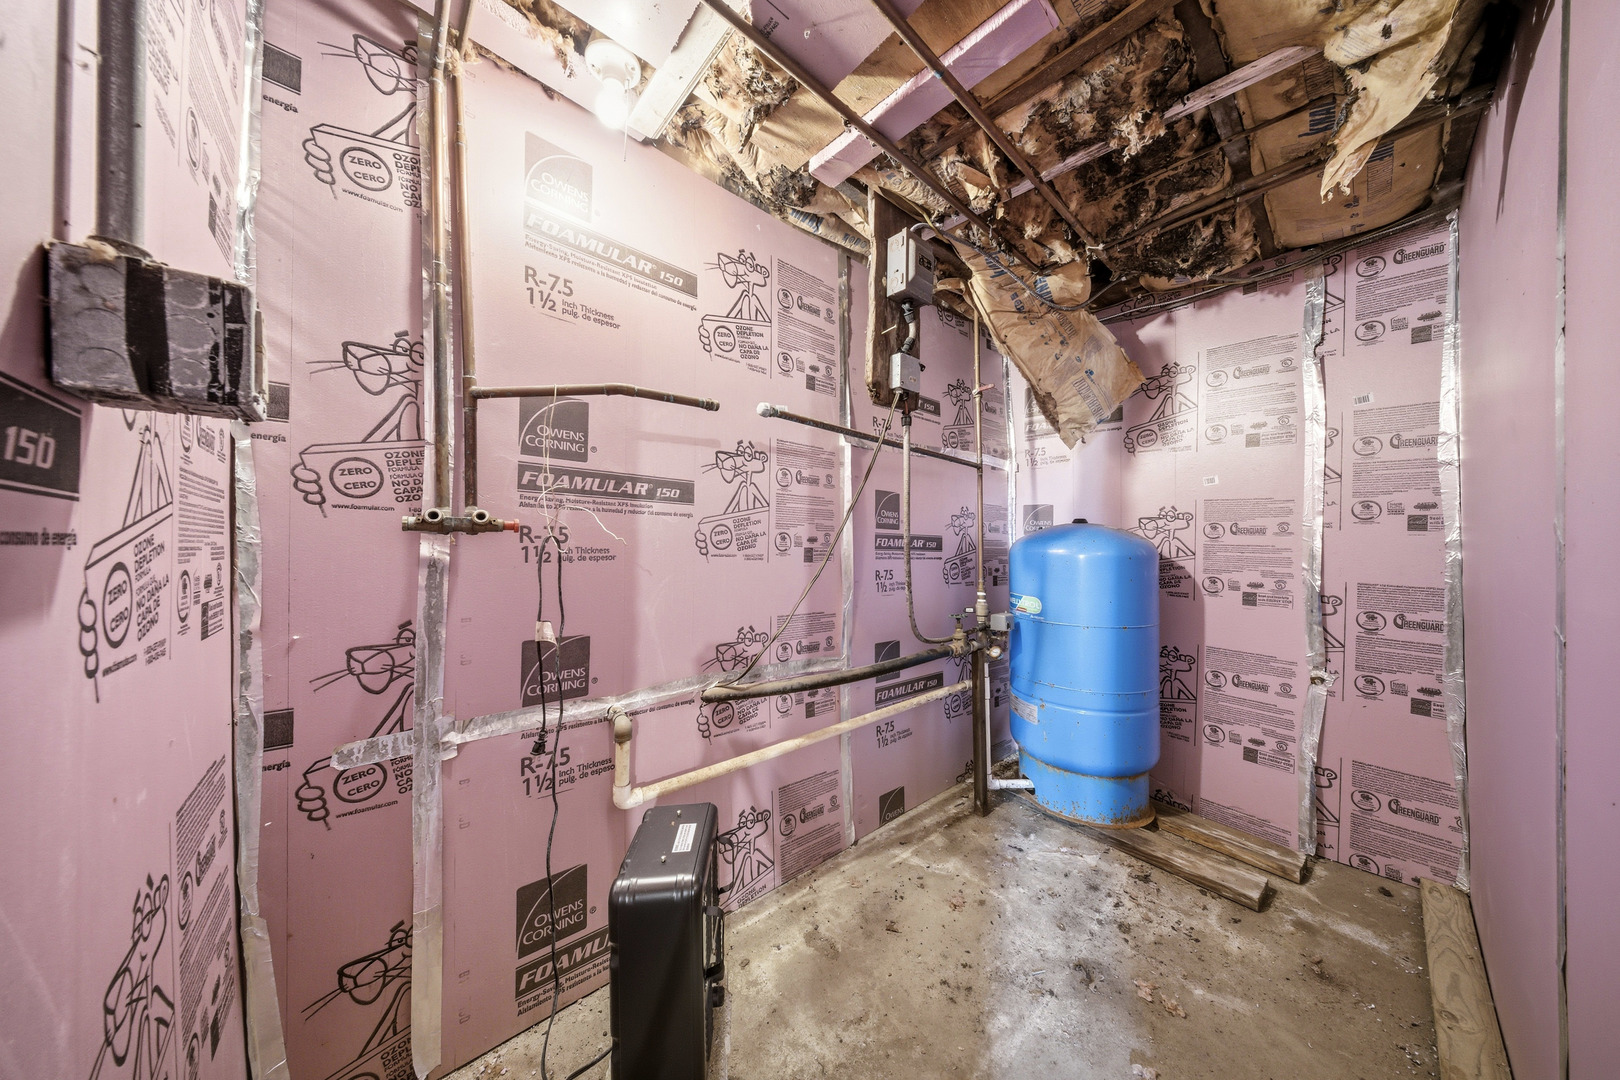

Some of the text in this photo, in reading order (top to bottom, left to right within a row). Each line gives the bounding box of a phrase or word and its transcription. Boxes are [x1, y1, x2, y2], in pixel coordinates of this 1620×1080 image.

[262, 93, 298, 113] energía
[348, 155, 382, 170] ZERO
[353, 172, 386, 184] CERO
[542, 172, 590, 200] OWENS
[530, 178, 588, 213] CORNING
[1392, 244, 1445, 265] GREENGUARD
[524, 264, 574, 298] R-7.5
[659, 270, 684, 288] 150
[562, 298, 616, 322] inch Thickness
[581, 312, 592, 322] de
[592, 316, 621, 330] espesor
[1233, 366, 1270, 380] GREENGUARD
[250, 432, 287, 444] energía
[536, 424, 584, 442] OWENS
[4, 426, 56, 470] 150
[526, 434, 585, 453] CORNING
[338, 466, 373, 476] ZERO
[343, 480, 377, 490] CERO
[392, 480, 410, 488] NO
[655, 486, 680, 498] 150
[877, 516, 899, 525] CORNING
[880, 510, 899, 518] OWENS
[1230, 522, 1267, 536] GREENGUARD
[134, 533, 154, 558] OZONE
[575, 546, 610, 554] Thickness
[134, 540, 166, 573] DEPLETION
[577, 554, 616, 564] de espesor
[108, 580, 128, 606] ZERO
[110, 606, 129, 632] CERO
[137, 602, 153, 627] CAPA
[137, 612, 160, 642] OZONO
[538, 667, 586, 683] OWENS
[926, 680, 938, 688] 150
[1232, 674, 1268, 692] GREENGUARD
[716, 706, 730, 716] ZERO
[718, 714, 732, 724] CERO
[342, 767, 376, 785] ZERO
[558, 757, 612, 778] inch Thickness
[558, 777, 578, 788] pulg.
[579, 770, 589, 780] de
[347, 780, 380, 797] CERO
[335, 800, 398, 819] www.foamular.com
[886, 806, 904, 820] OWENS
[1388, 798, 1440, 824] GREENGUARD
[534, 898, 584, 928] OWENS
